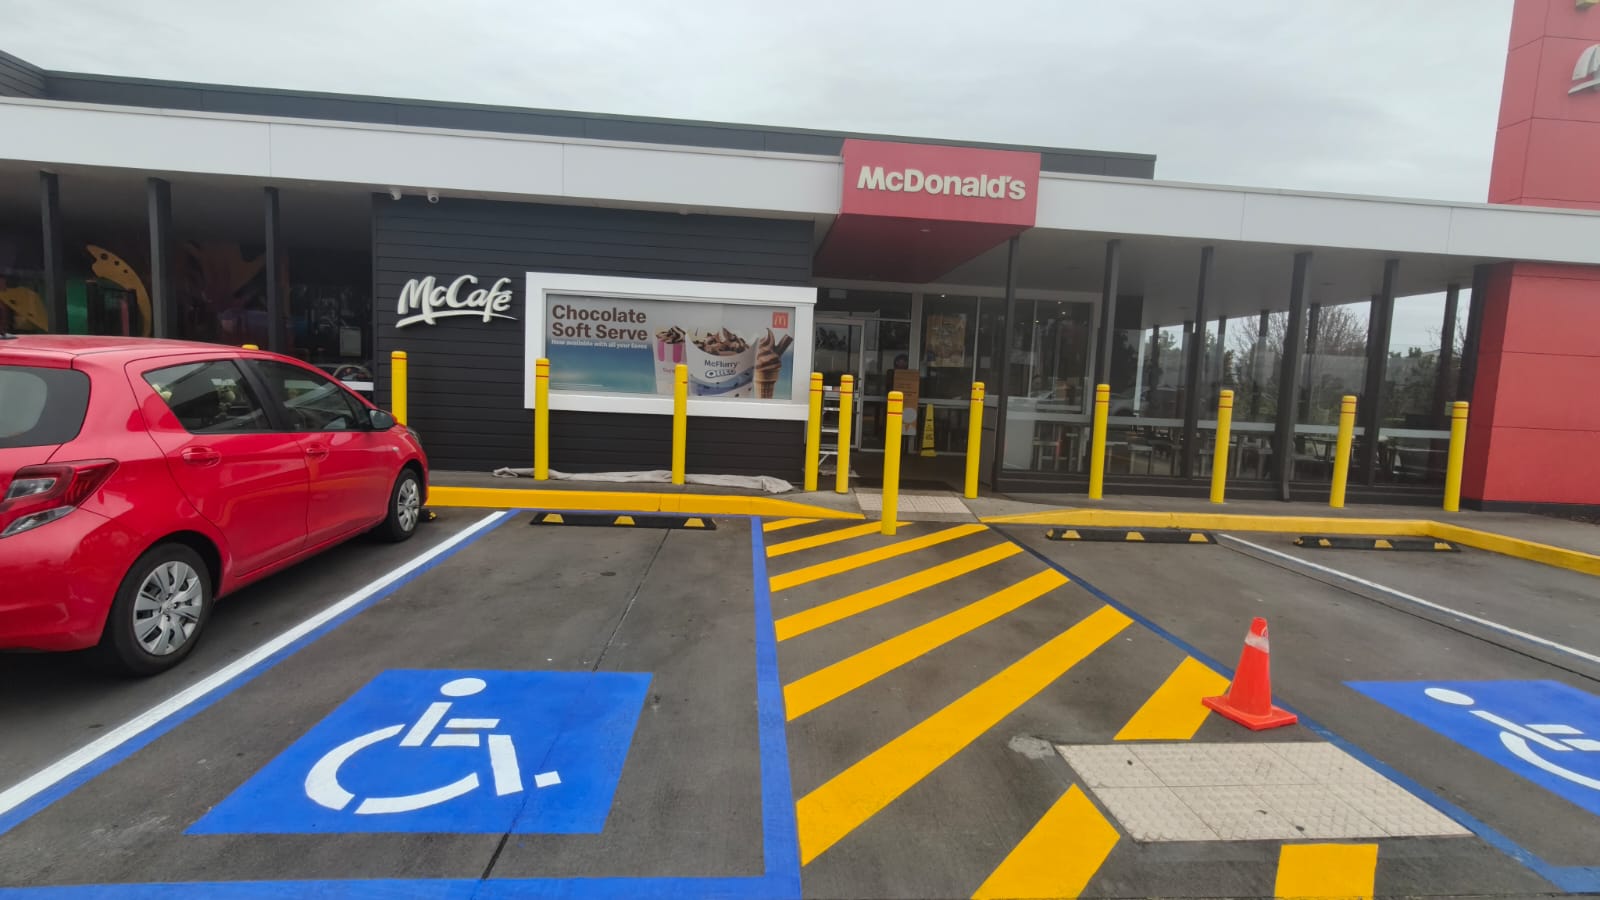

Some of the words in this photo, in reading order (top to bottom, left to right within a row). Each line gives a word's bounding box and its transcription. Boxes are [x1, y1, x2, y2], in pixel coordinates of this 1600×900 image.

[857, 166, 1026, 200] McDonald's
[552, 304, 647, 324] Chocolate
[552, 322, 592, 339] Soft
[595, 324, 649, 341] Serve
